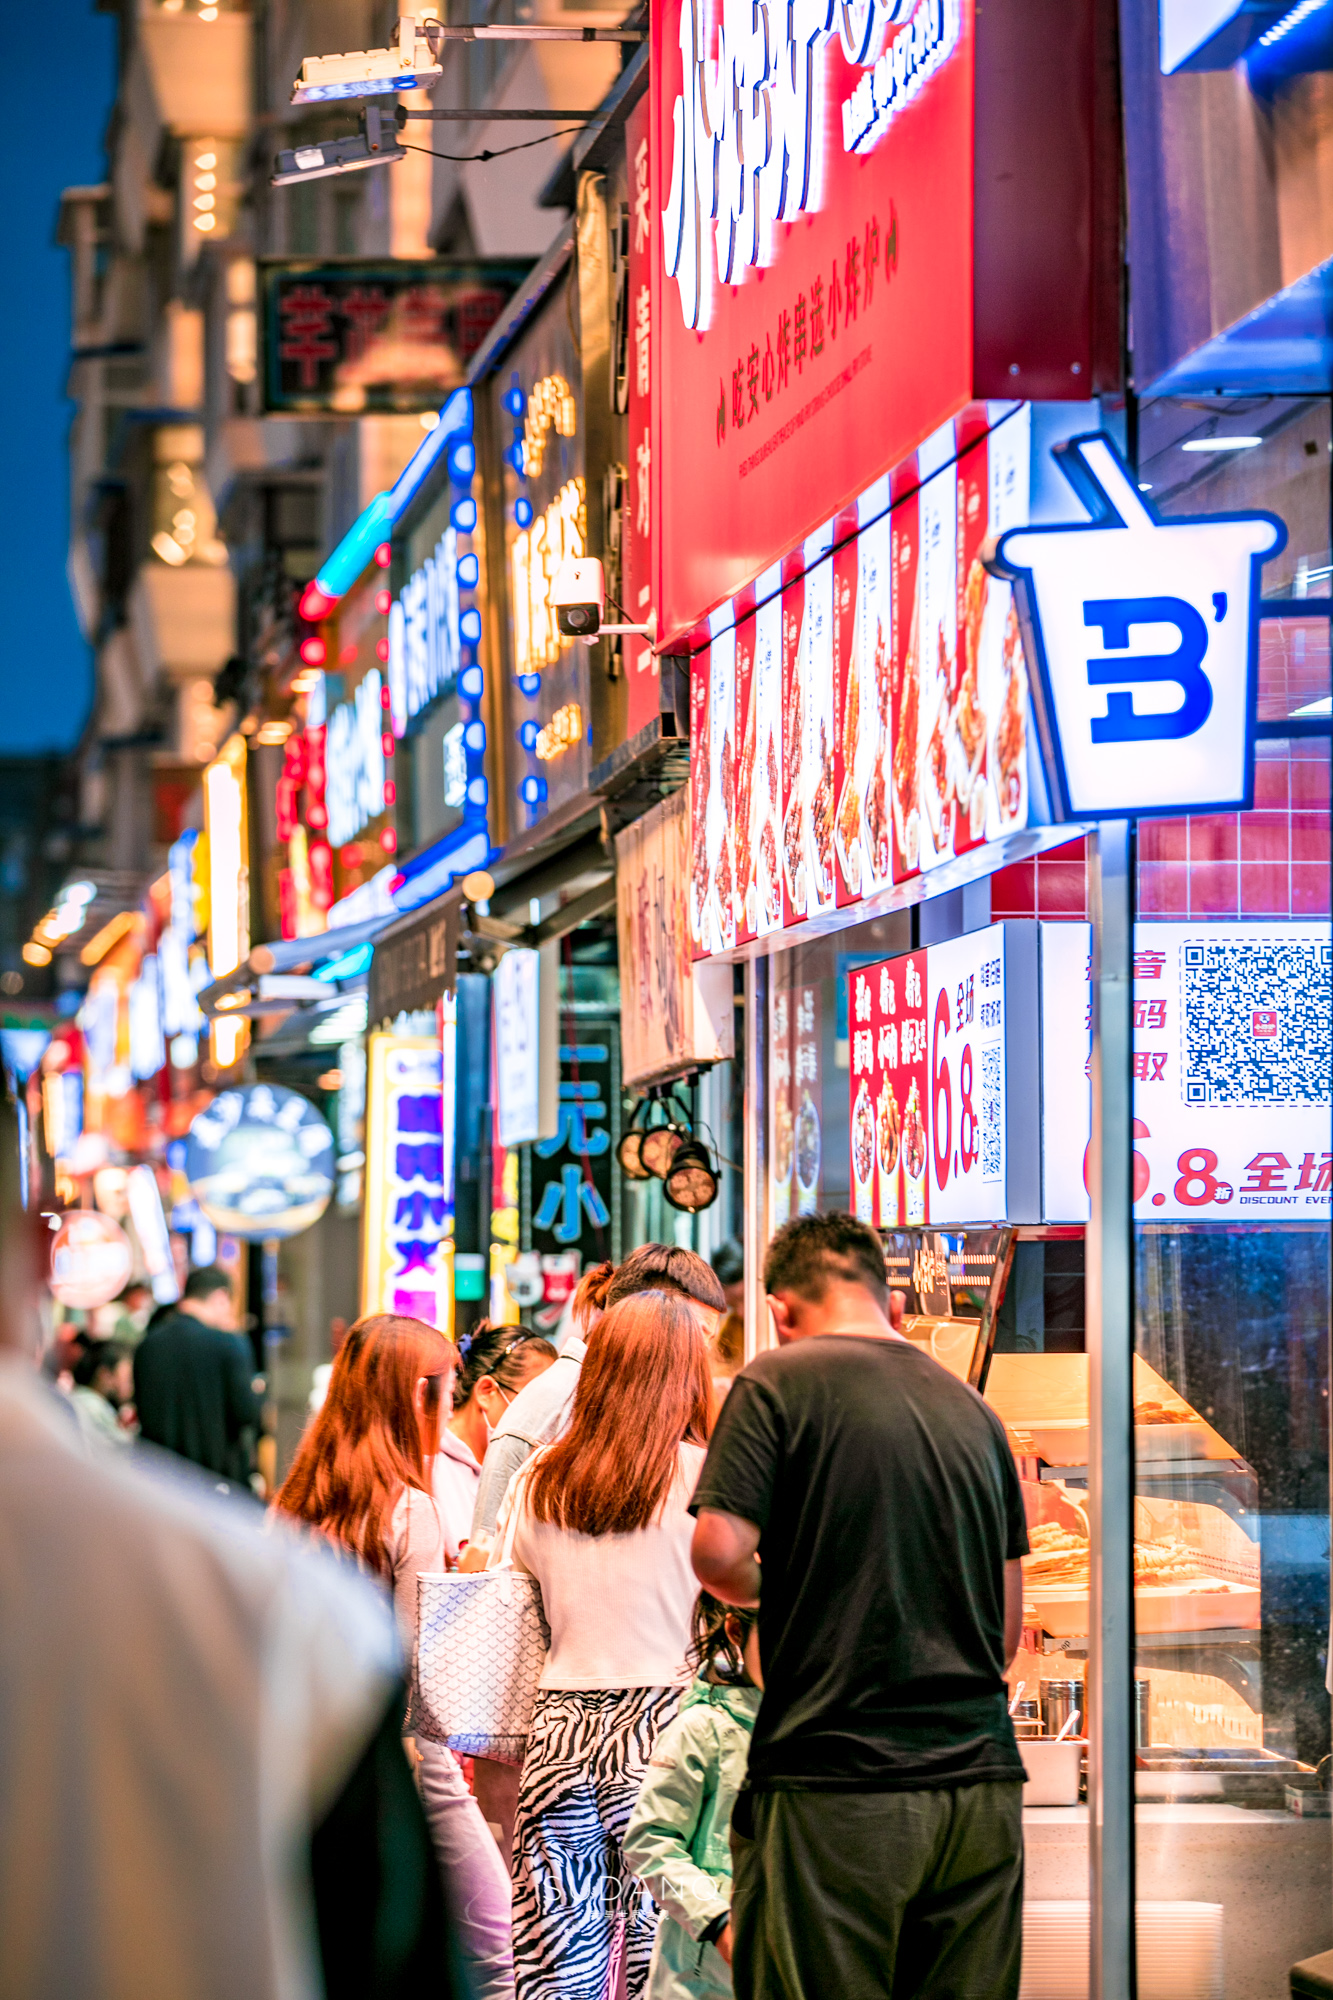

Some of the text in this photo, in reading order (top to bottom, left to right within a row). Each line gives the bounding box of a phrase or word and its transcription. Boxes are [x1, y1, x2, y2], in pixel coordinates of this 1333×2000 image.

[732, 214, 880, 429] 吃安心炸串选小炸炉
[1239, 1196, 1298, 1204] DISCOUNT
